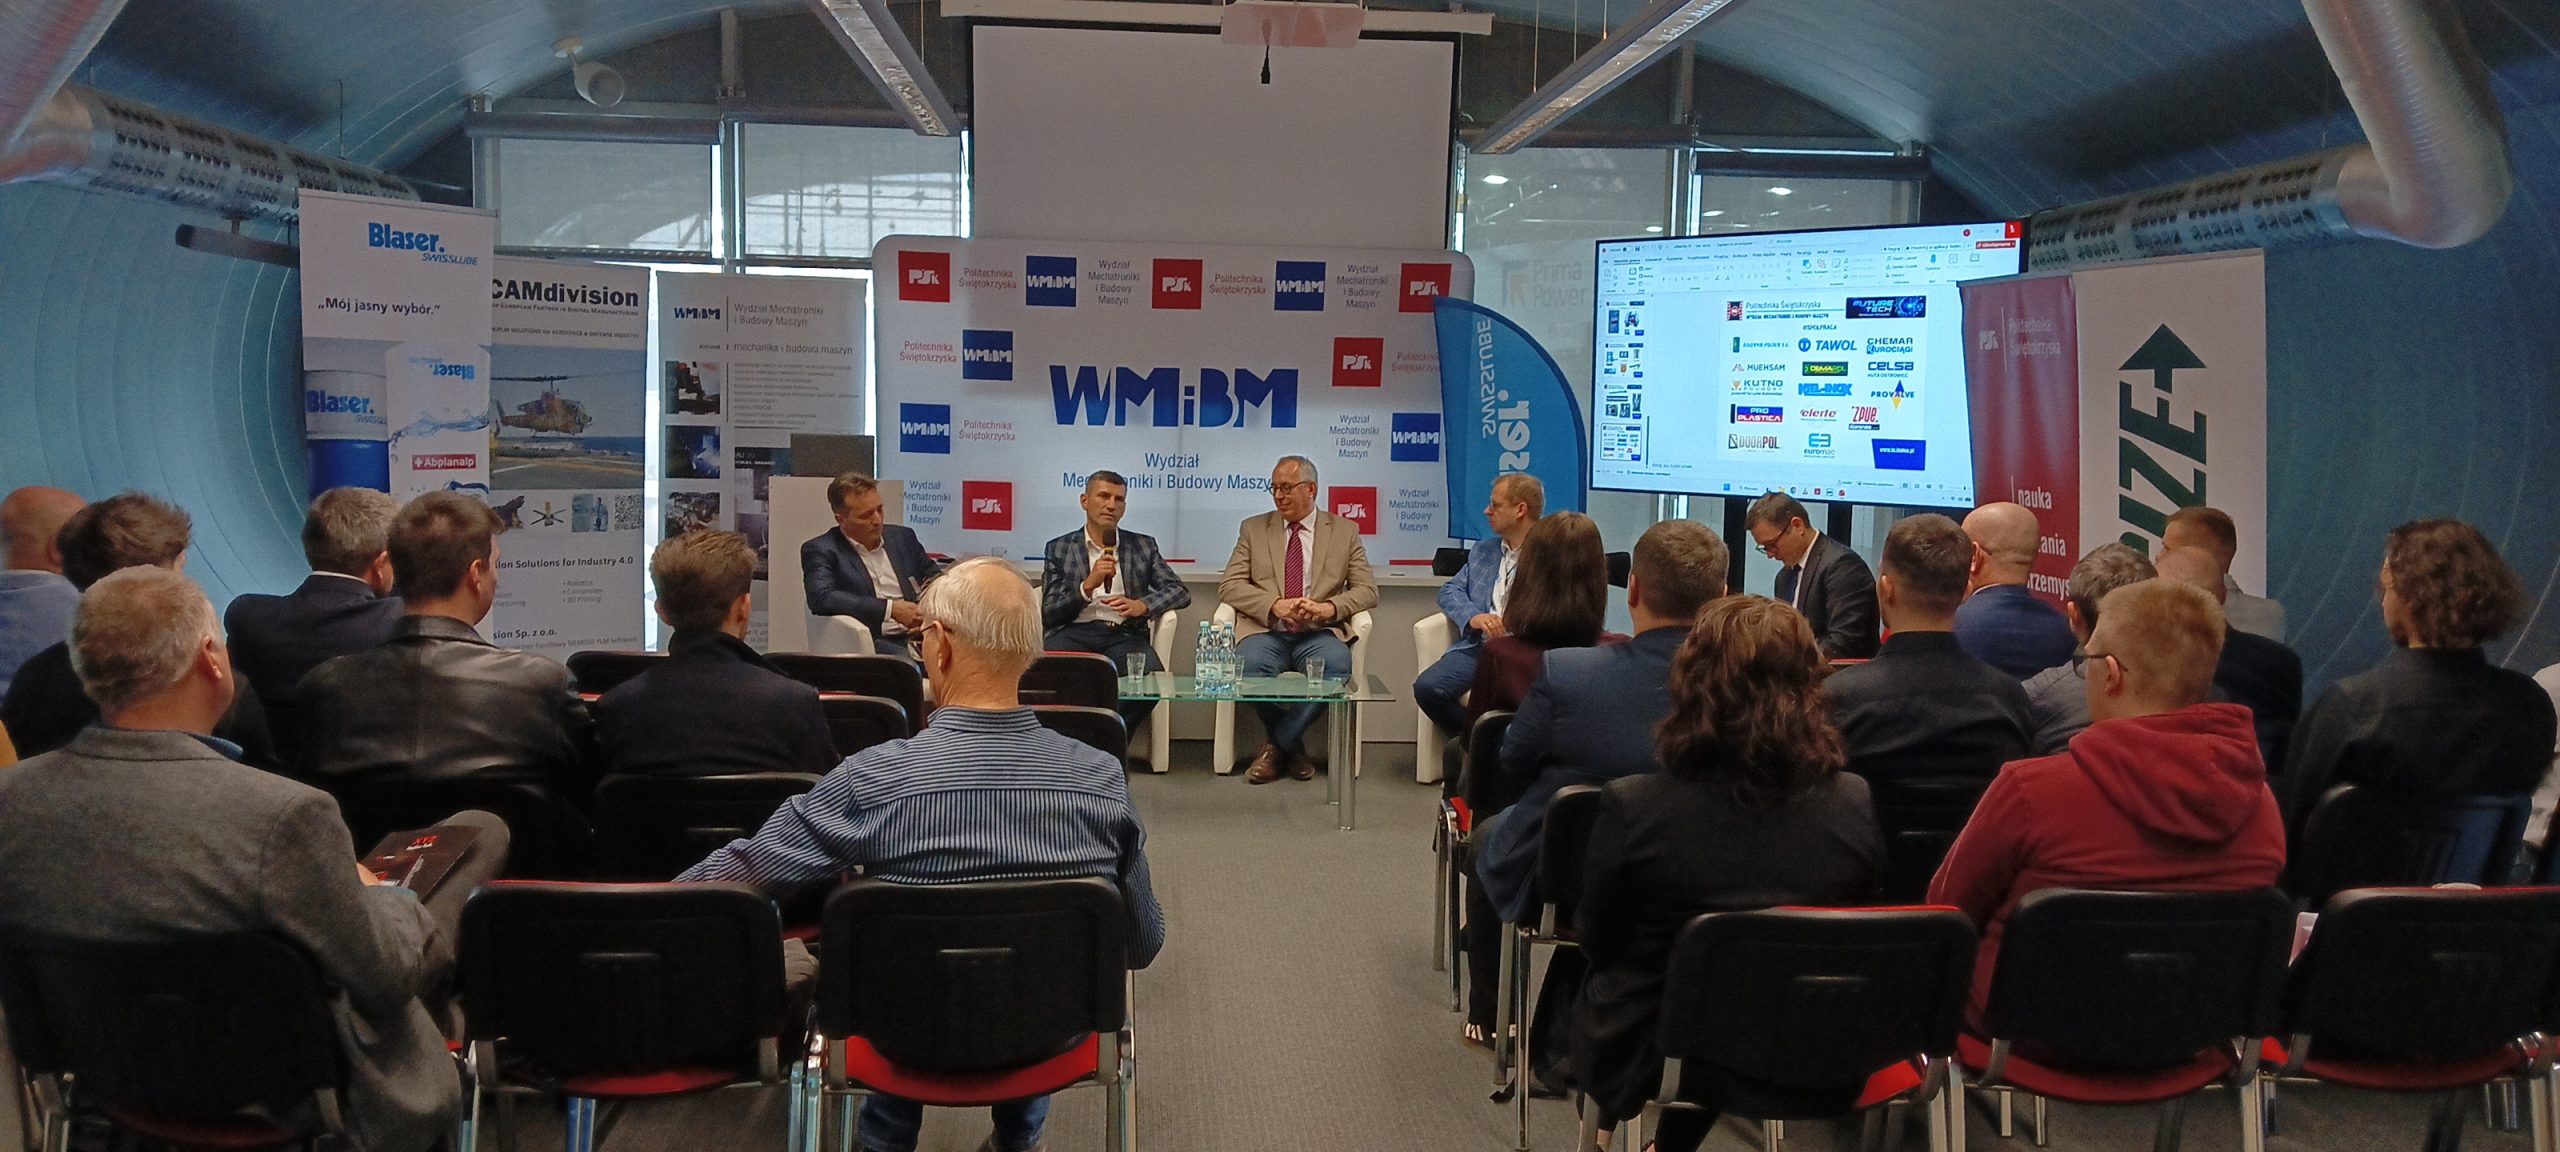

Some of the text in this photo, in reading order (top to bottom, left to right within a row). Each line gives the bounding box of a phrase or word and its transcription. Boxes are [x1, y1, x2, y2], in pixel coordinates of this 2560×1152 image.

[368, 222, 445, 253] Blaser.
[422, 253, 479, 265] SWISSLUBE
[1098, 260, 1131, 270] Wydział
[1347, 263, 1379, 275] Wydział
[964, 267, 1013, 278] Politechnika
[1088, 271, 1140, 281] Mechatroniki
[958, 277, 1017, 290] Świętokrzyska
[1214, 273, 1264, 284] Politechnika
[1336, 275, 1389, 286] Mechatroniki
[1100, 283, 1133, 294] Budowy
[1209, 283, 1266, 296] Świętokrzyska
[1348, 287, 1380, 298] Budowy
[1098, 295, 1129, 306] Maszyn
[1346, 299, 1376, 309] Maszyn
[354, 298, 388, 315] jasny
[904, 341, 954, 352] Politechnika
[1815, 339, 1857, 351] TAWOL
[1867, 337, 1913, 345] CHEMAR
[900, 350, 957, 363] Świętokrzyska
[1747, 363, 1786, 371] MUEHSAM
[1743, 379, 1783, 387] KUTNO
[1049, 365, 1299, 429] WMiBM
[1870, 390, 1915, 398] PROVALVE
[306, 390, 375, 415] Blaser.
[1340, 413, 1370, 425] Wydział
[1737, 414, 1782, 422] PLASTICA
[963, 418, 1012, 431] Politechnika
[958, 429, 1016, 442] Świętokrzyska
[1329, 425, 1380, 436] Mechatroniki
[1341, 437, 1372, 448] Budowy
[1338, 448, 1369, 459] Maszyn
[424, 456, 475, 469] Abplanalp
[1145, 453, 1200, 471] Wydział
[909, 480, 941, 491] Wydział
[1167, 474, 1222, 492] Budowy
[1227, 474, 1272, 493] Maszy
[1399, 488, 1430, 499] Wydział
[2018, 486, 2053, 509] nauka
[911, 503, 944, 515] Budowy
[1388, 498, 1440, 510] Mechatroniki
[910, 514, 941, 526] Maszyn
[1400, 511, 1432, 522] Budowy
[1398, 522, 1429, 533] Maszyn
[2038, 533, 2067, 556] ania
[515, 557, 560, 569] Solutions
[562, 557, 576, 567] for
[577, 556, 617, 567] Industry
[618, 556, 634, 565] 4.0
[2027, 573, 2070, 601] rzemys
[515, 629, 530, 639] Sp.
[539, 629, 557, 637] o.o.
